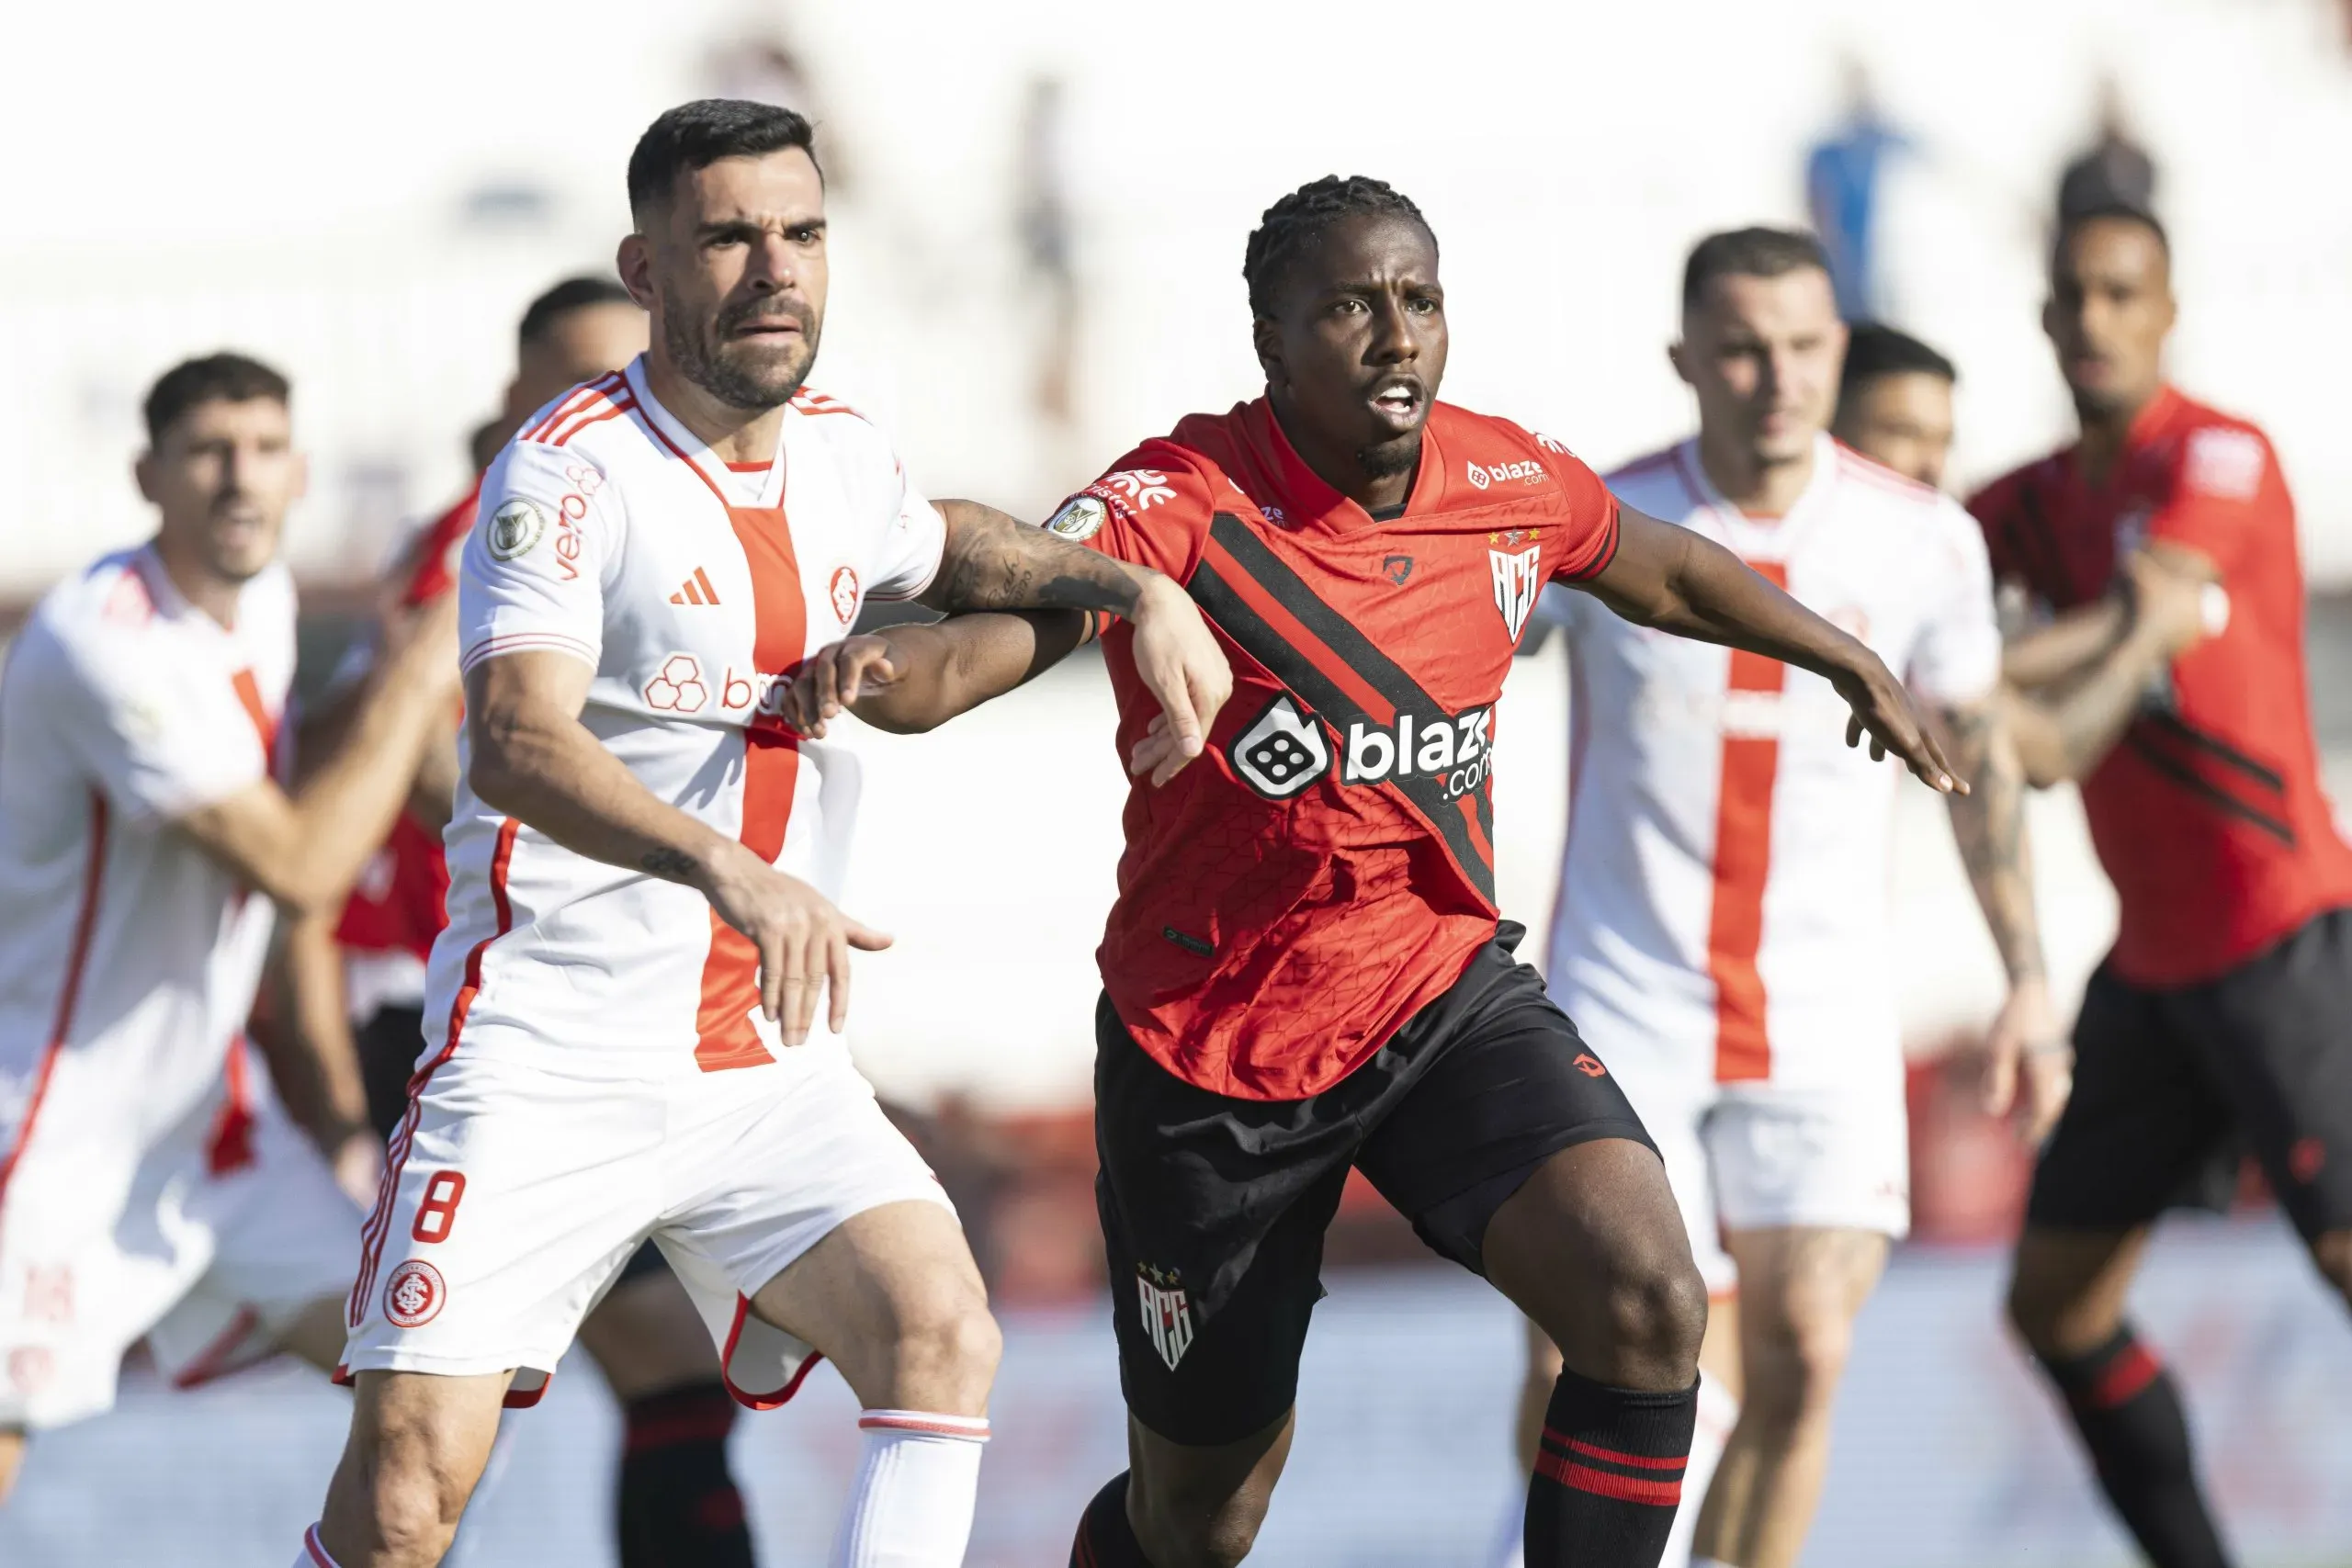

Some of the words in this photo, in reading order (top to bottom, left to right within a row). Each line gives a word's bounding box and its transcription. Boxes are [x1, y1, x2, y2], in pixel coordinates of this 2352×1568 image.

[1487, 460, 1543, 481] blaze
[556, 494, 587, 580] vero
[412, 1170, 466, 1244] 8
